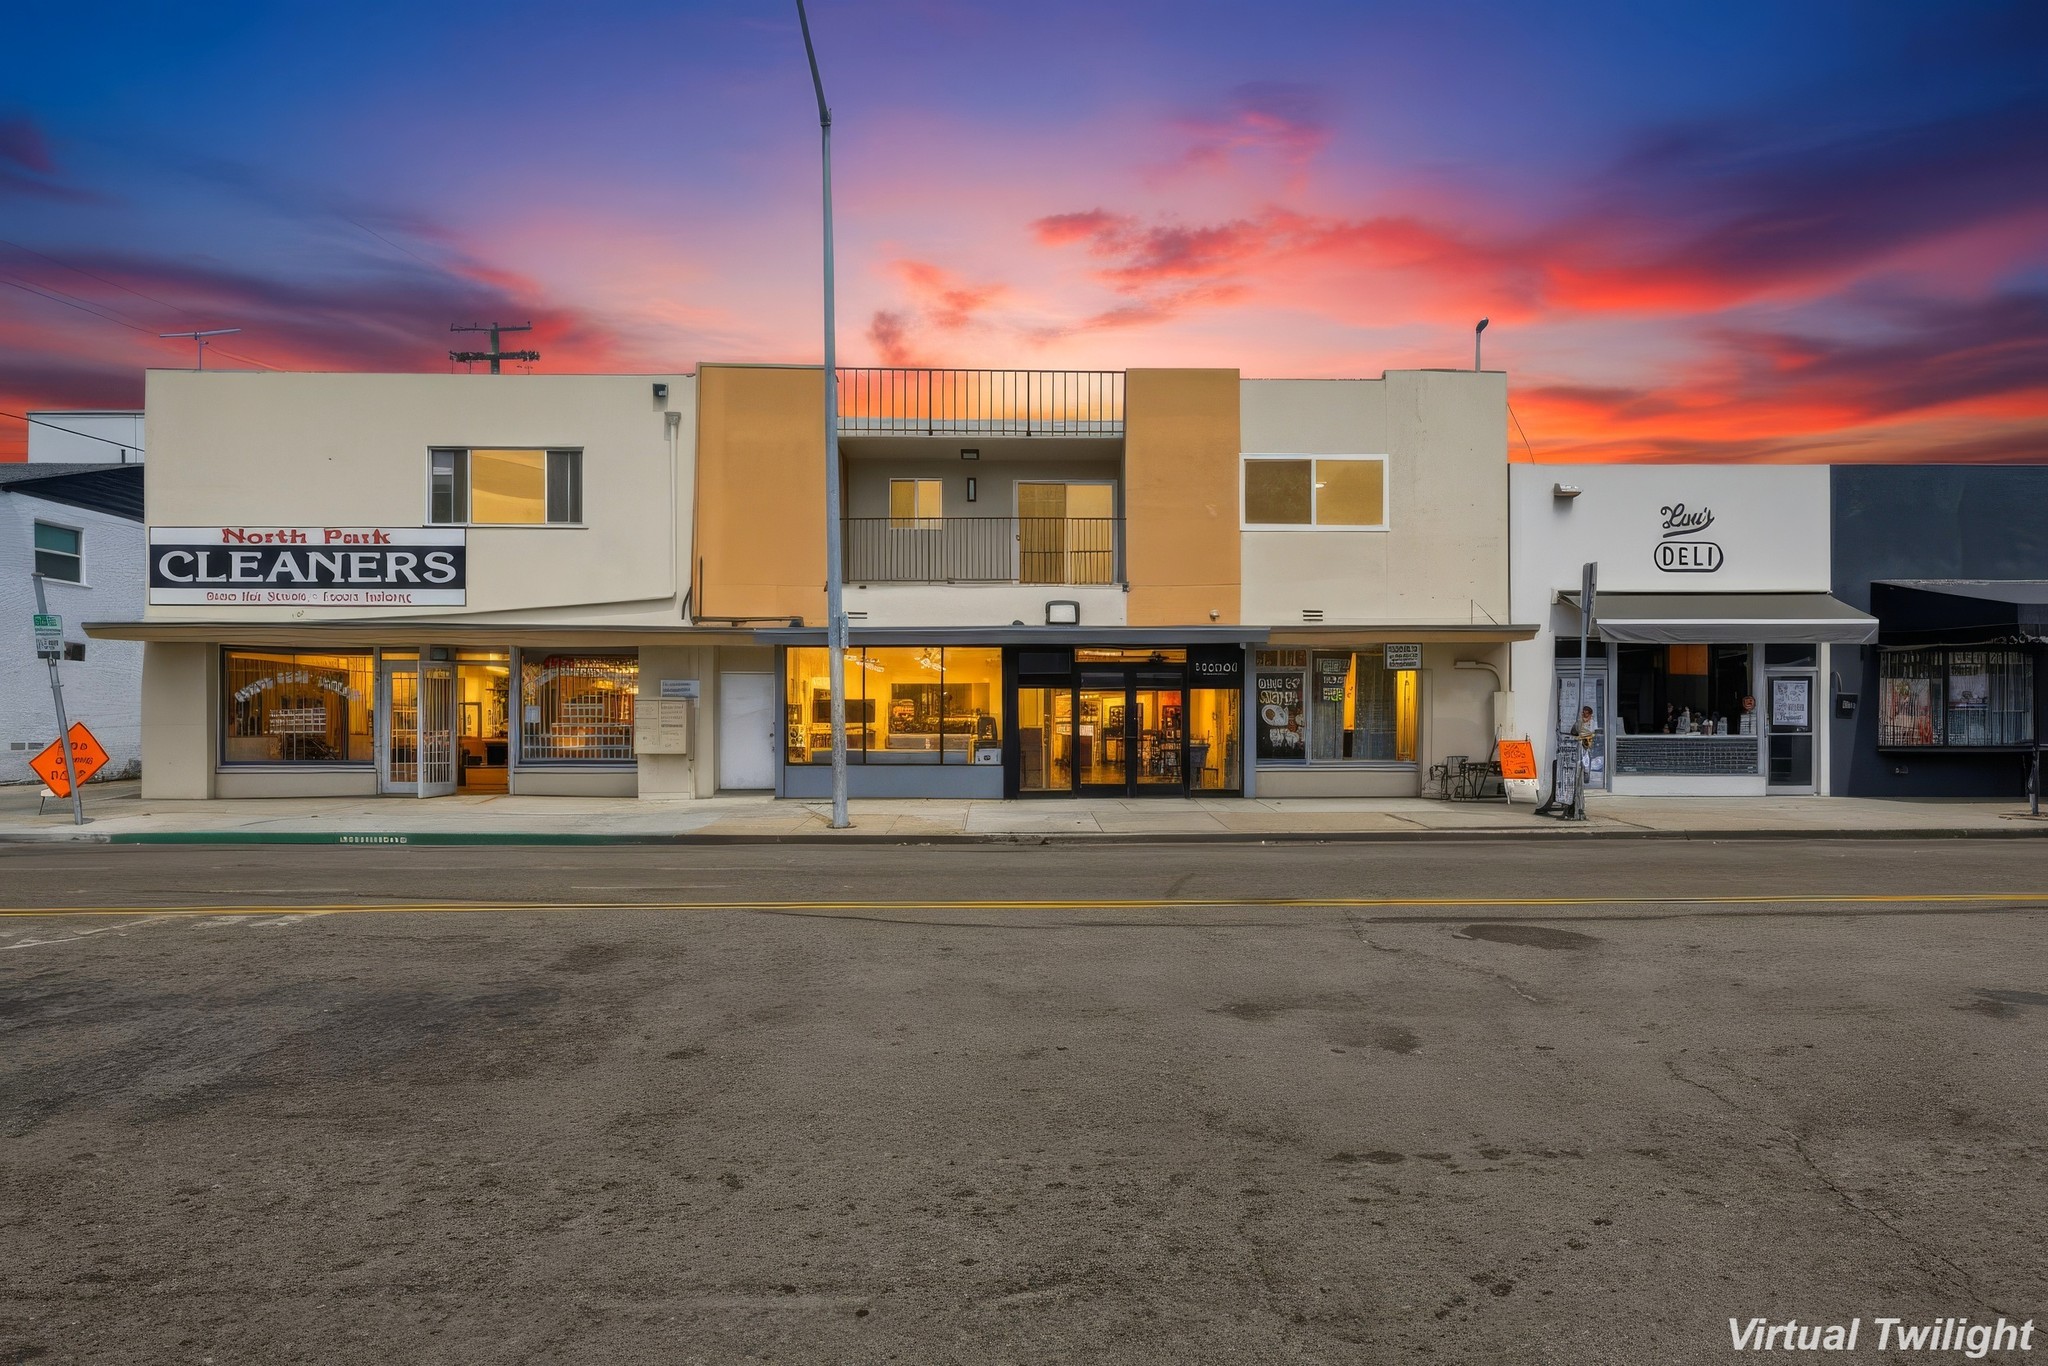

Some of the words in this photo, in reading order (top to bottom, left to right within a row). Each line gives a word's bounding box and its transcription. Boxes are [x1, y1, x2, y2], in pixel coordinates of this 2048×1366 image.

[222, 528, 307, 544] North
[323, 528, 391, 545] Park
[1663, 546, 1712, 566] DELI
[158, 550, 457, 584] CLEANERS
